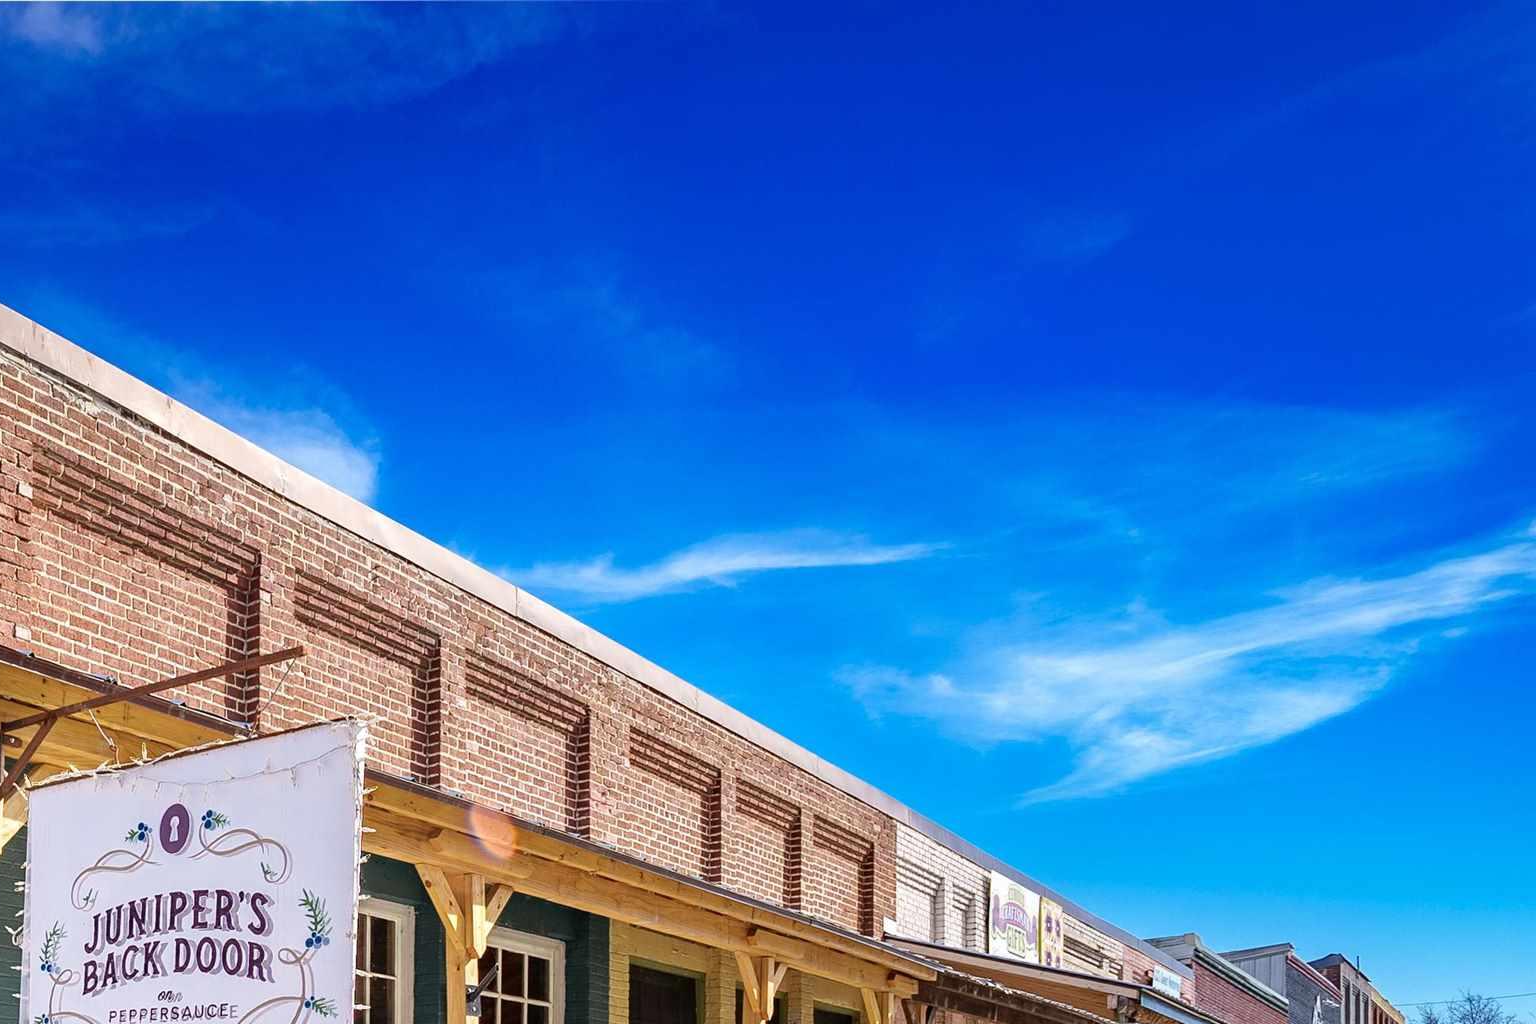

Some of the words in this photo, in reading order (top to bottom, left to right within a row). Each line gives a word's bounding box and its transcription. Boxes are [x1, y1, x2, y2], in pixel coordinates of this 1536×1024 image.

[83, 889, 270, 954] JUNIPER'S
[82, 940, 163, 996] BACK
[173, 936, 269, 983] DOOR
[108, 1003, 233, 1023] PEPPERSAUCE
[157, 990, 175, 1001] on
